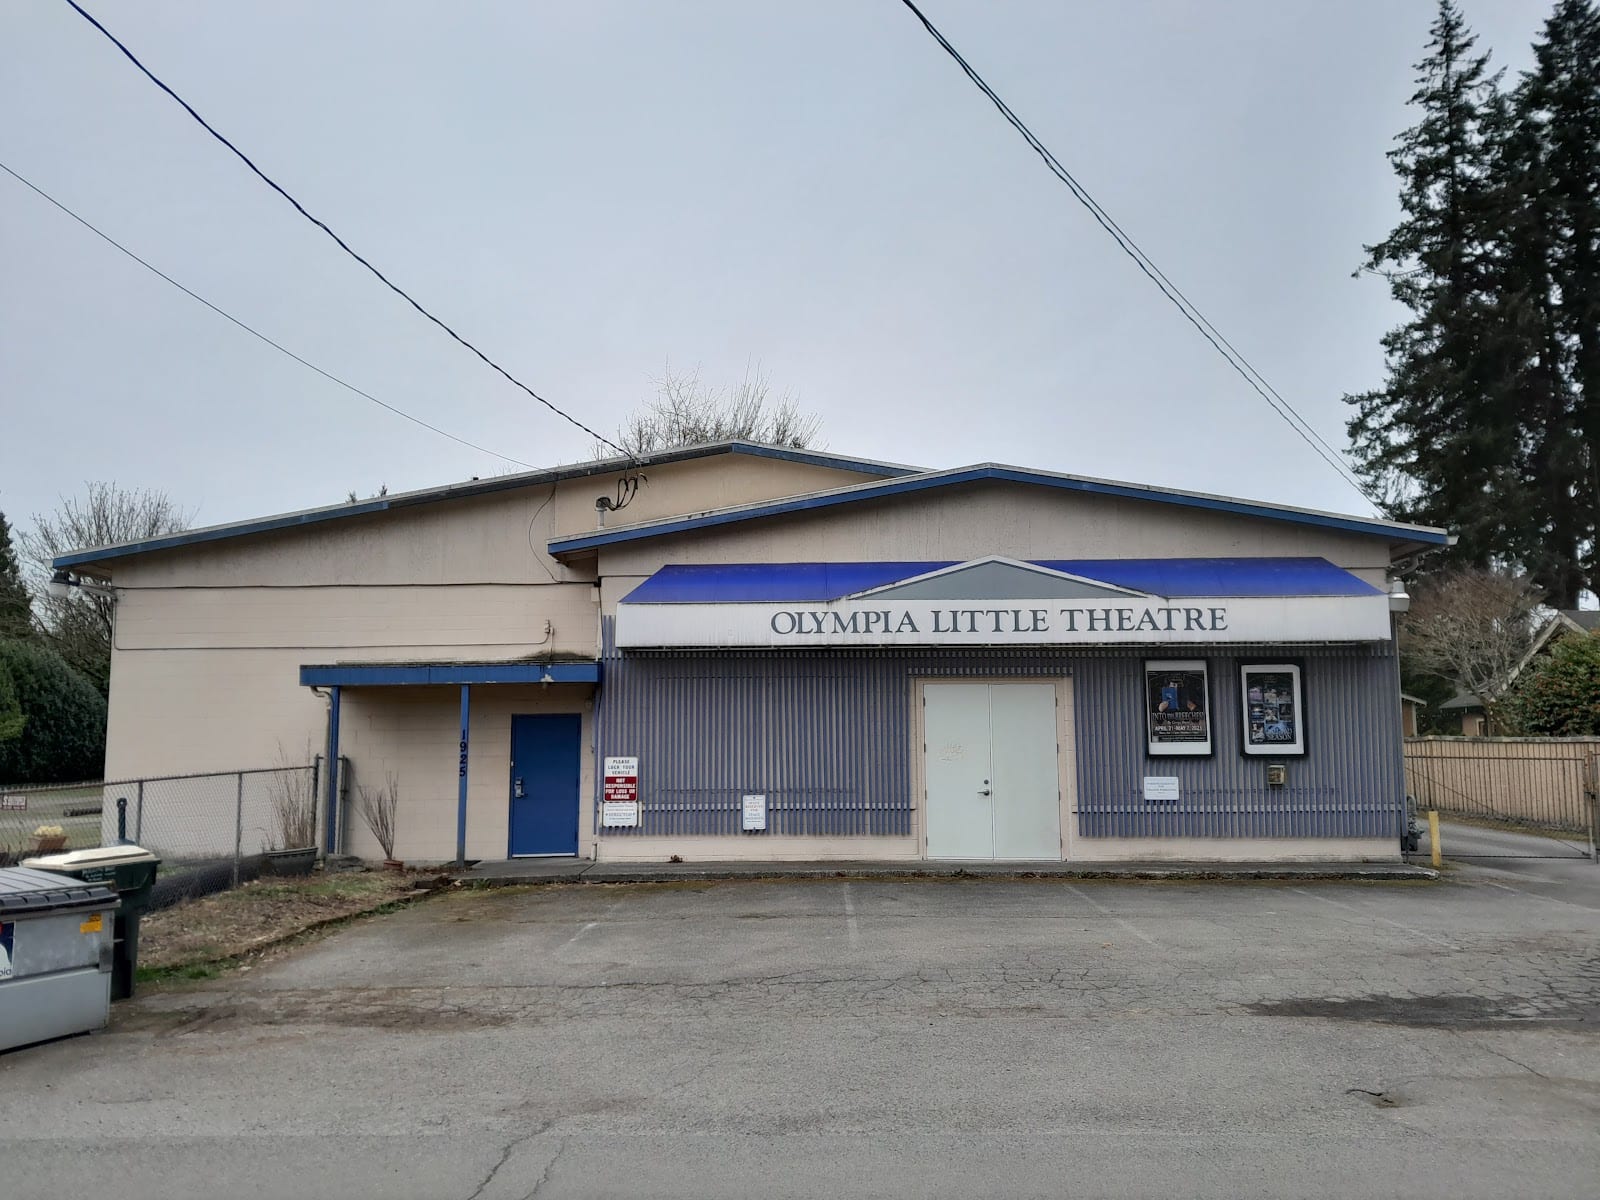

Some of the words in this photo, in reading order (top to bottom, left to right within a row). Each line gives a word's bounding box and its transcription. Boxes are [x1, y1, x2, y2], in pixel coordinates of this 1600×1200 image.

[771, 610, 920, 634] OLYMPIA
[931, 609, 1049, 632] LITTLE
[1060, 607, 1228, 631] THEATRE
[459, 729, 467, 777] 1925
